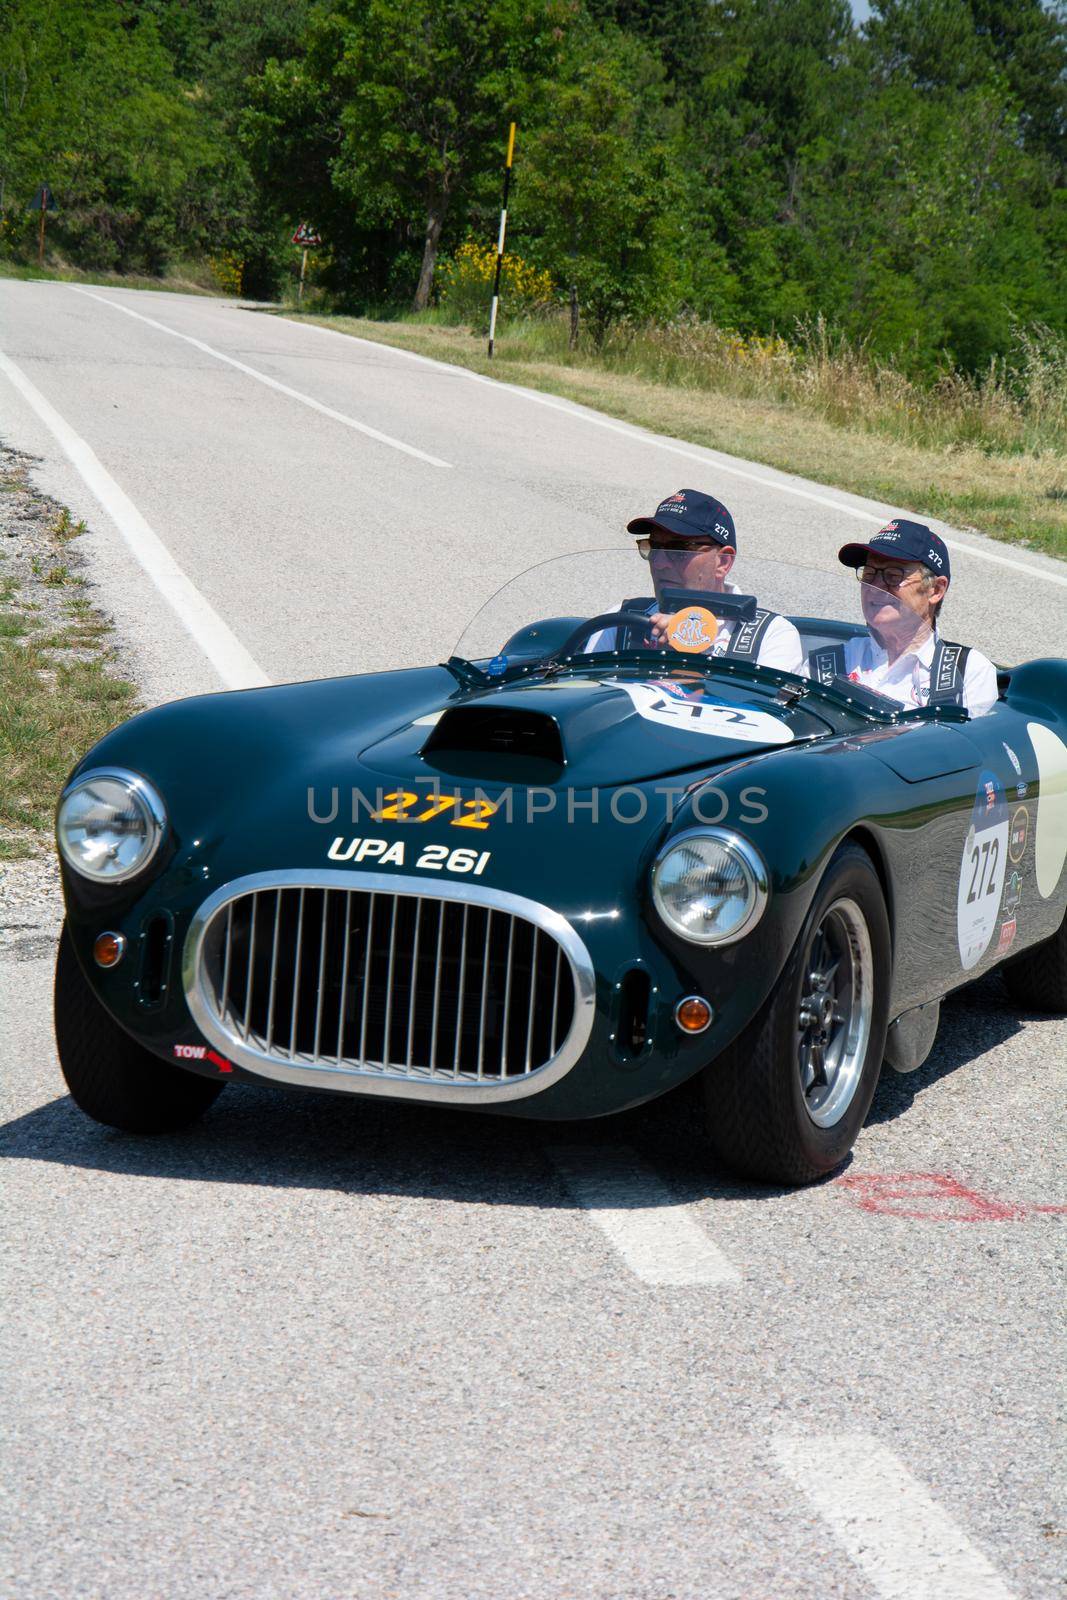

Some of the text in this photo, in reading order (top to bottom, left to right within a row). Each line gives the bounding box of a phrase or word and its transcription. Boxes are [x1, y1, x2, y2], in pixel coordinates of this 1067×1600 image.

[714, 523, 730, 540] 272
[927, 549, 943, 569] 272
[370, 791, 499, 830] 272
[327, 836, 492, 876] UPA 261
[966, 837, 1000, 905] 272
[174, 1044, 206, 1059] TOW
